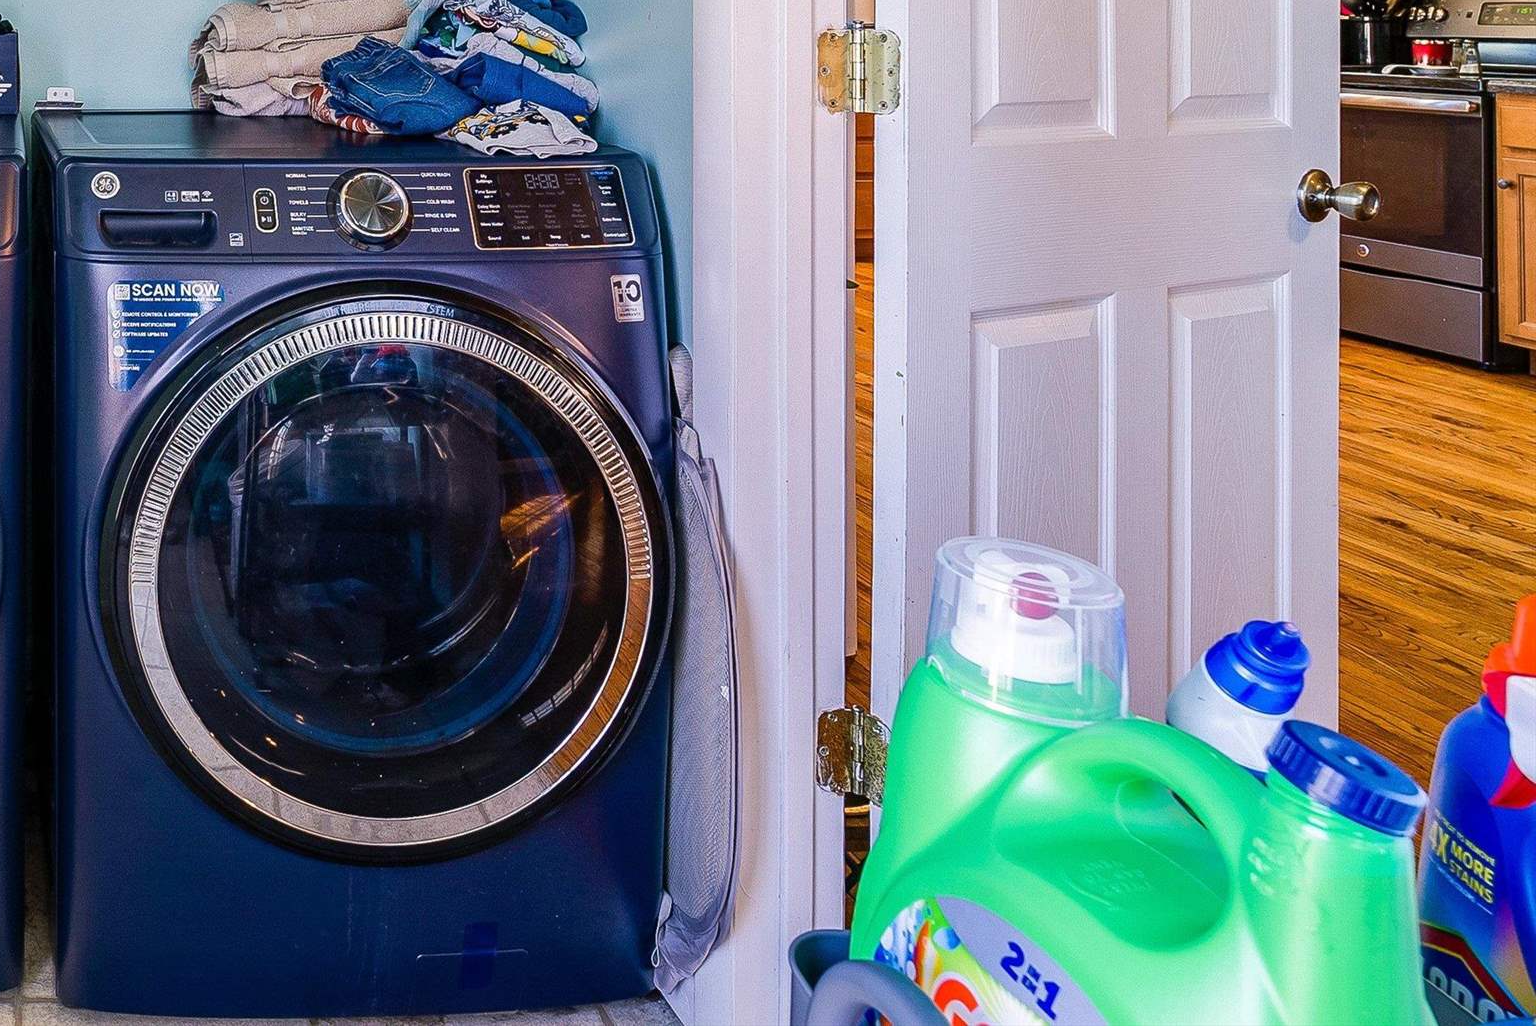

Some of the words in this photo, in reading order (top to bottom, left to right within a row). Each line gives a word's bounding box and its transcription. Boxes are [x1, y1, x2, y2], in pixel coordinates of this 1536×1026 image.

[132, 284, 175, 296] SCAN
[181, 284, 219, 296] NOW
[613, 280, 641, 302] 10
[1450, 840, 1495, 887] MORE
[1449, 860, 1495, 905] STAINS
